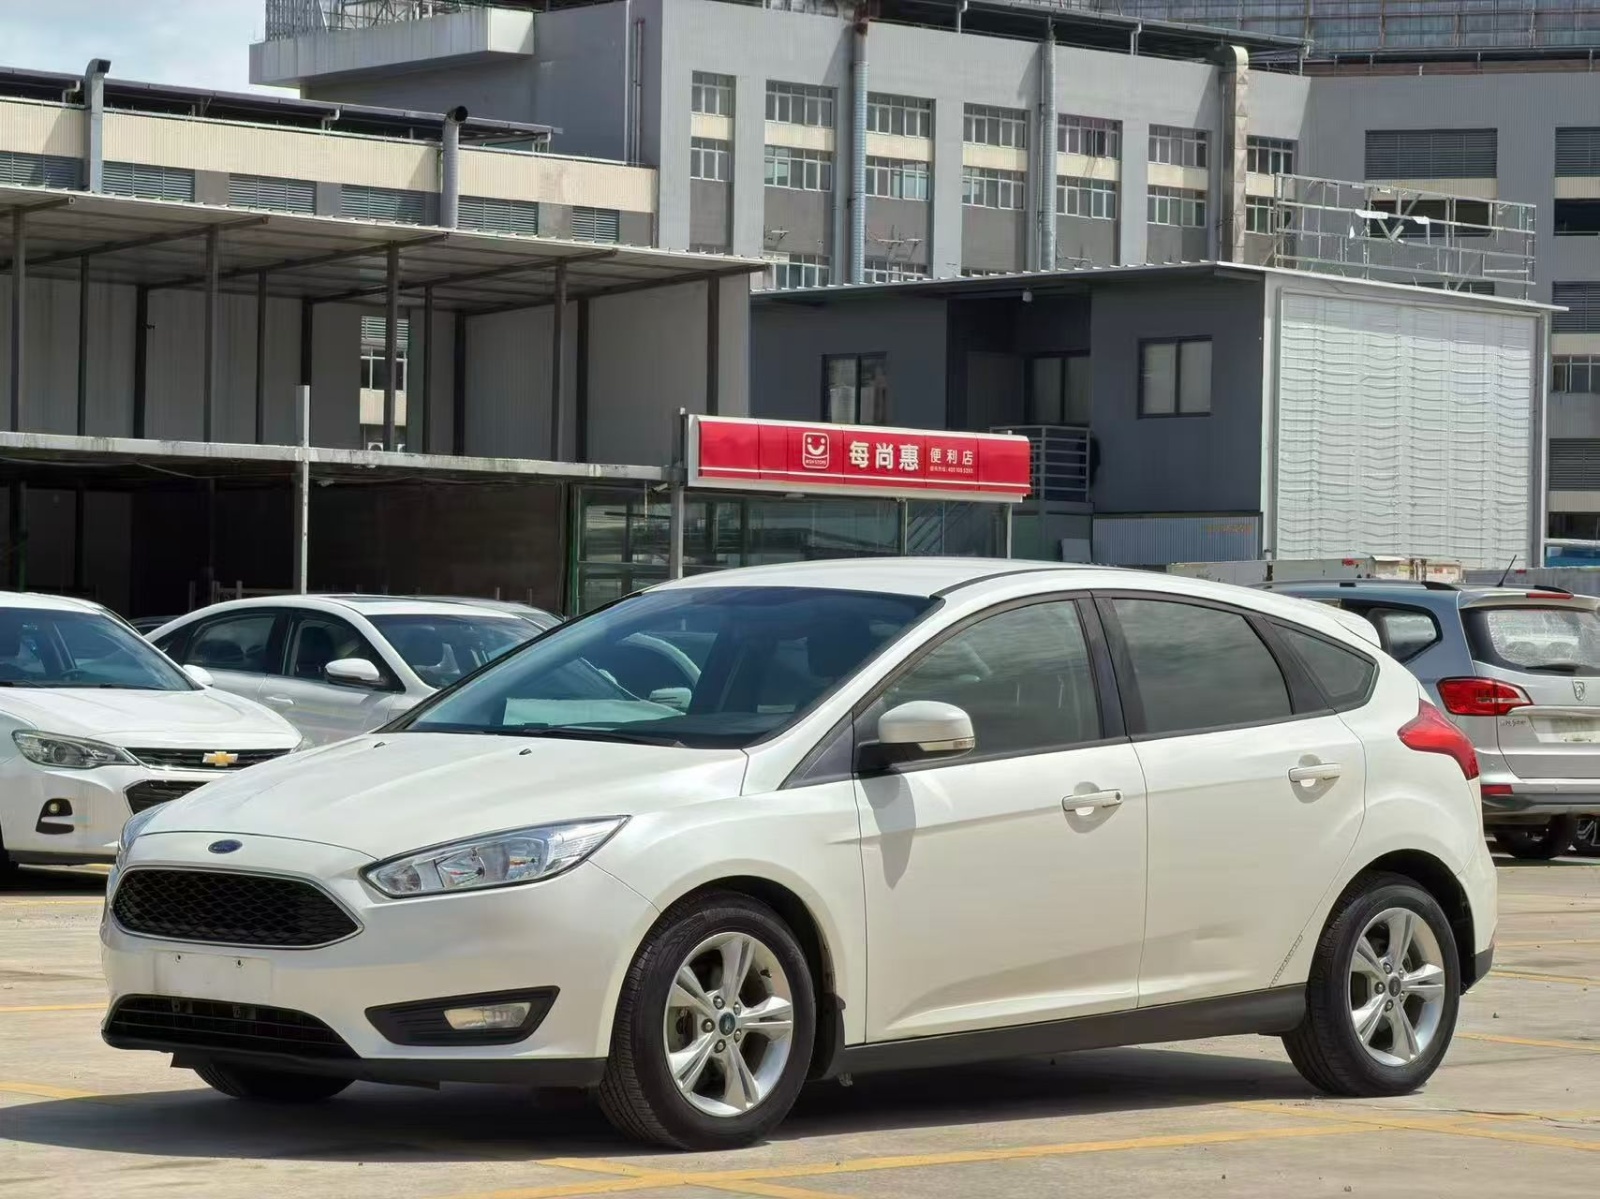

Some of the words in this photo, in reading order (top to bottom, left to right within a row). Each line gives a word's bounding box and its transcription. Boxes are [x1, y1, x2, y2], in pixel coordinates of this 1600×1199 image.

[850, 441, 919, 471] 每尚惠
[930, 448, 973, 465] 便利店
